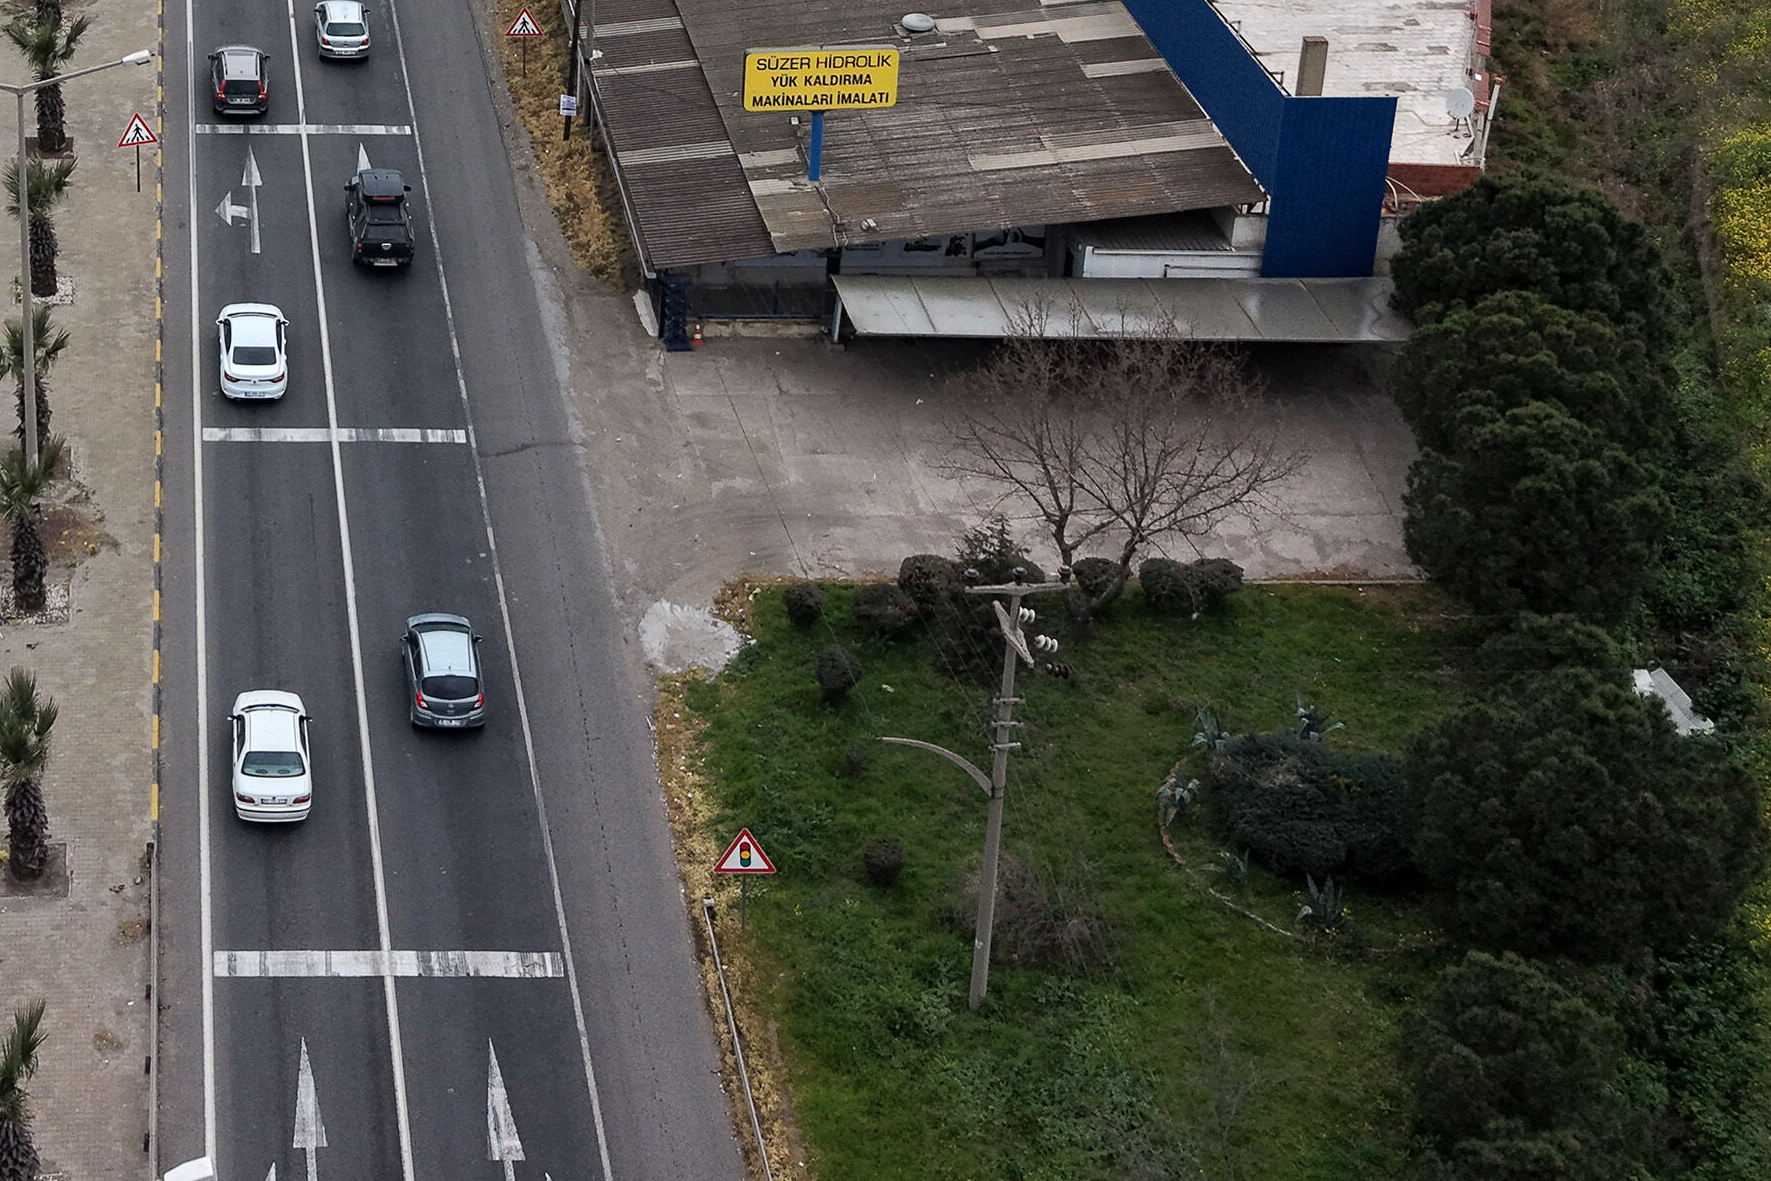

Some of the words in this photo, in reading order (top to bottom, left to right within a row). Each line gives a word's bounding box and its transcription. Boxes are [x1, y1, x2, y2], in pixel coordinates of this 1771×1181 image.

[756, 56, 811, 71] SÜZER
[816, 53, 892, 69] HİDROLİK
[771, 74, 798, 88] YÜK
[804, 74, 872, 87] KALDIRMA
[752, 92, 833, 107] MAKİNALARI
[837, 90, 889, 105] İMALATI
